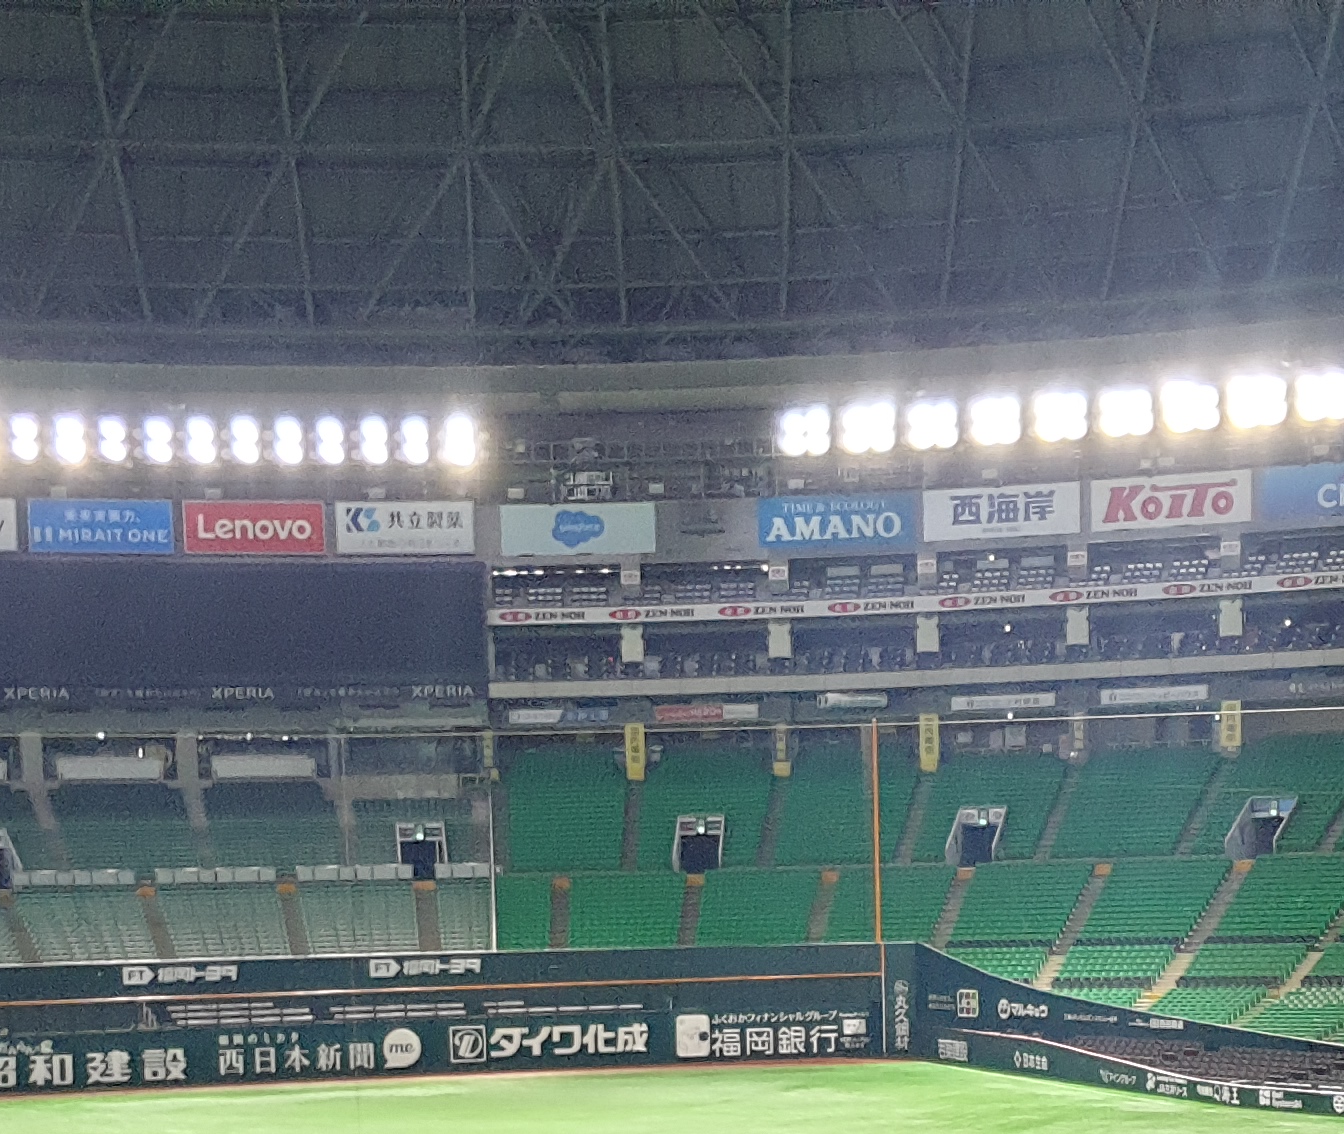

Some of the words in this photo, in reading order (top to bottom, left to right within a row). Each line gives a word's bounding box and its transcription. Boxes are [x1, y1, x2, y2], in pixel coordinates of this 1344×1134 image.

[950, 489, 1055, 527] 西海岸
[58, 527, 125, 545] MIRAIT
[127, 526, 169, 544] ONE
[196, 512, 312, 541] Lenovo
[766, 511, 902, 543] AMANO
[710, 1009, 838, 1025] ふくおかフィナンシャルグループ
[389, 1040, 414, 1053] me
[488, 1022, 648, 1057] ダイワ化成
[710, 1025, 839, 1058] 福岡銀行
[218, 1042, 376, 1076] 西日本新聞
